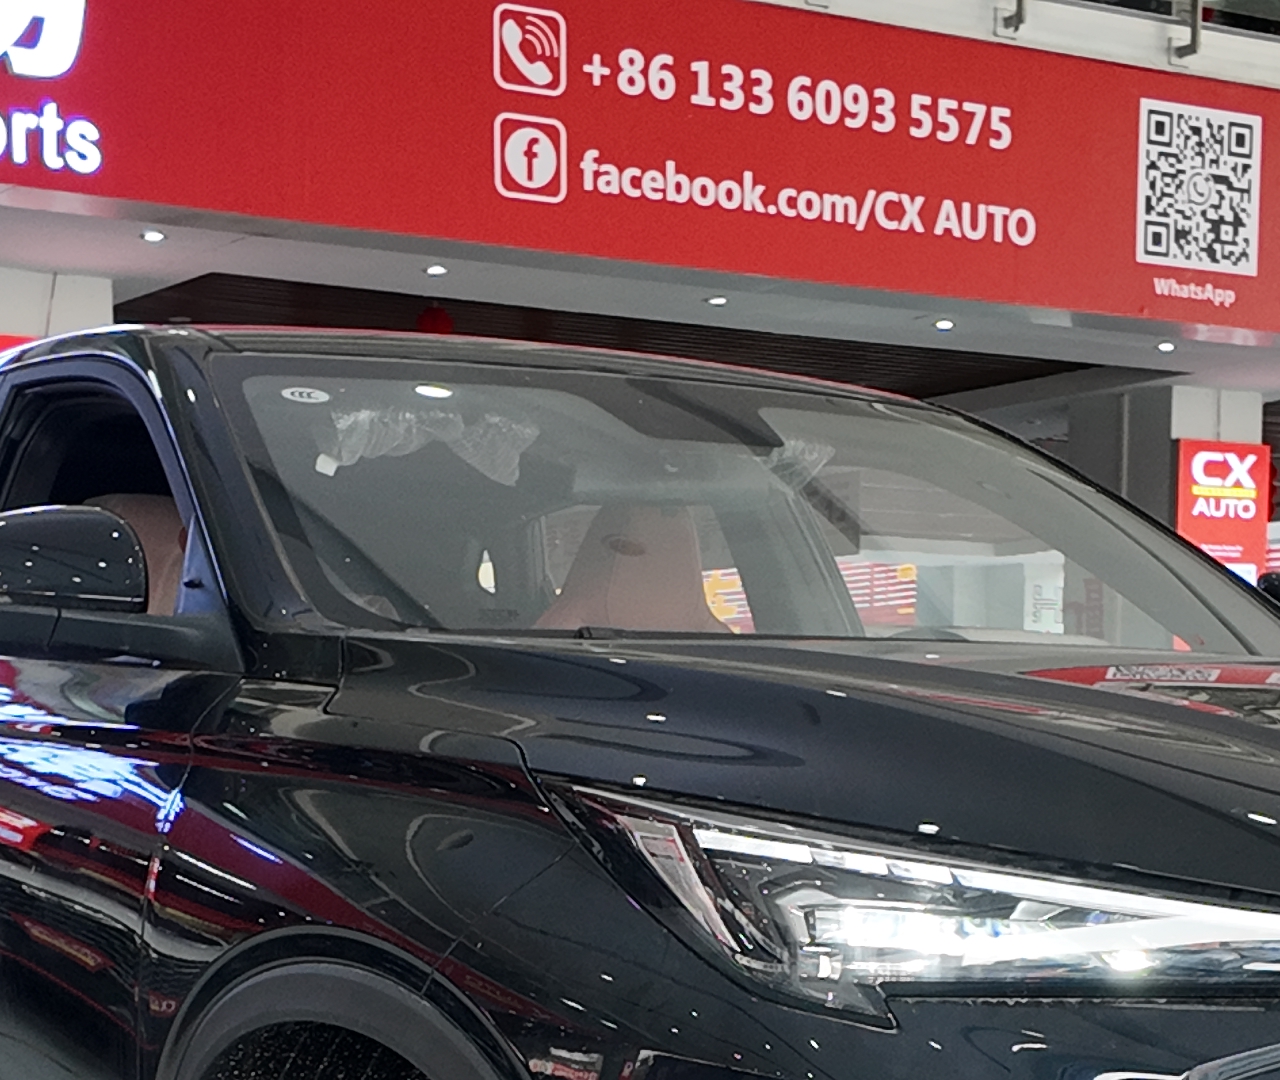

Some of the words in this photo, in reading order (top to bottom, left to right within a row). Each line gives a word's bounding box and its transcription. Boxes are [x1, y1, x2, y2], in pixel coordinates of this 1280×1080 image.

[582, 48, 677, 101] +86
[689, 59, 774, 115] 133
[786, 75, 897, 133] 6093
[908, 93, 1013, 150] 5575
[579, 149, 926, 233] facebook.com/CX
[933, 199, 1037, 247] AUTO
[1152, 277, 1236, 308] WhatsApp
[1191, 450, 1258, 489] CX
[1191, 497, 1257, 520] AUTO
